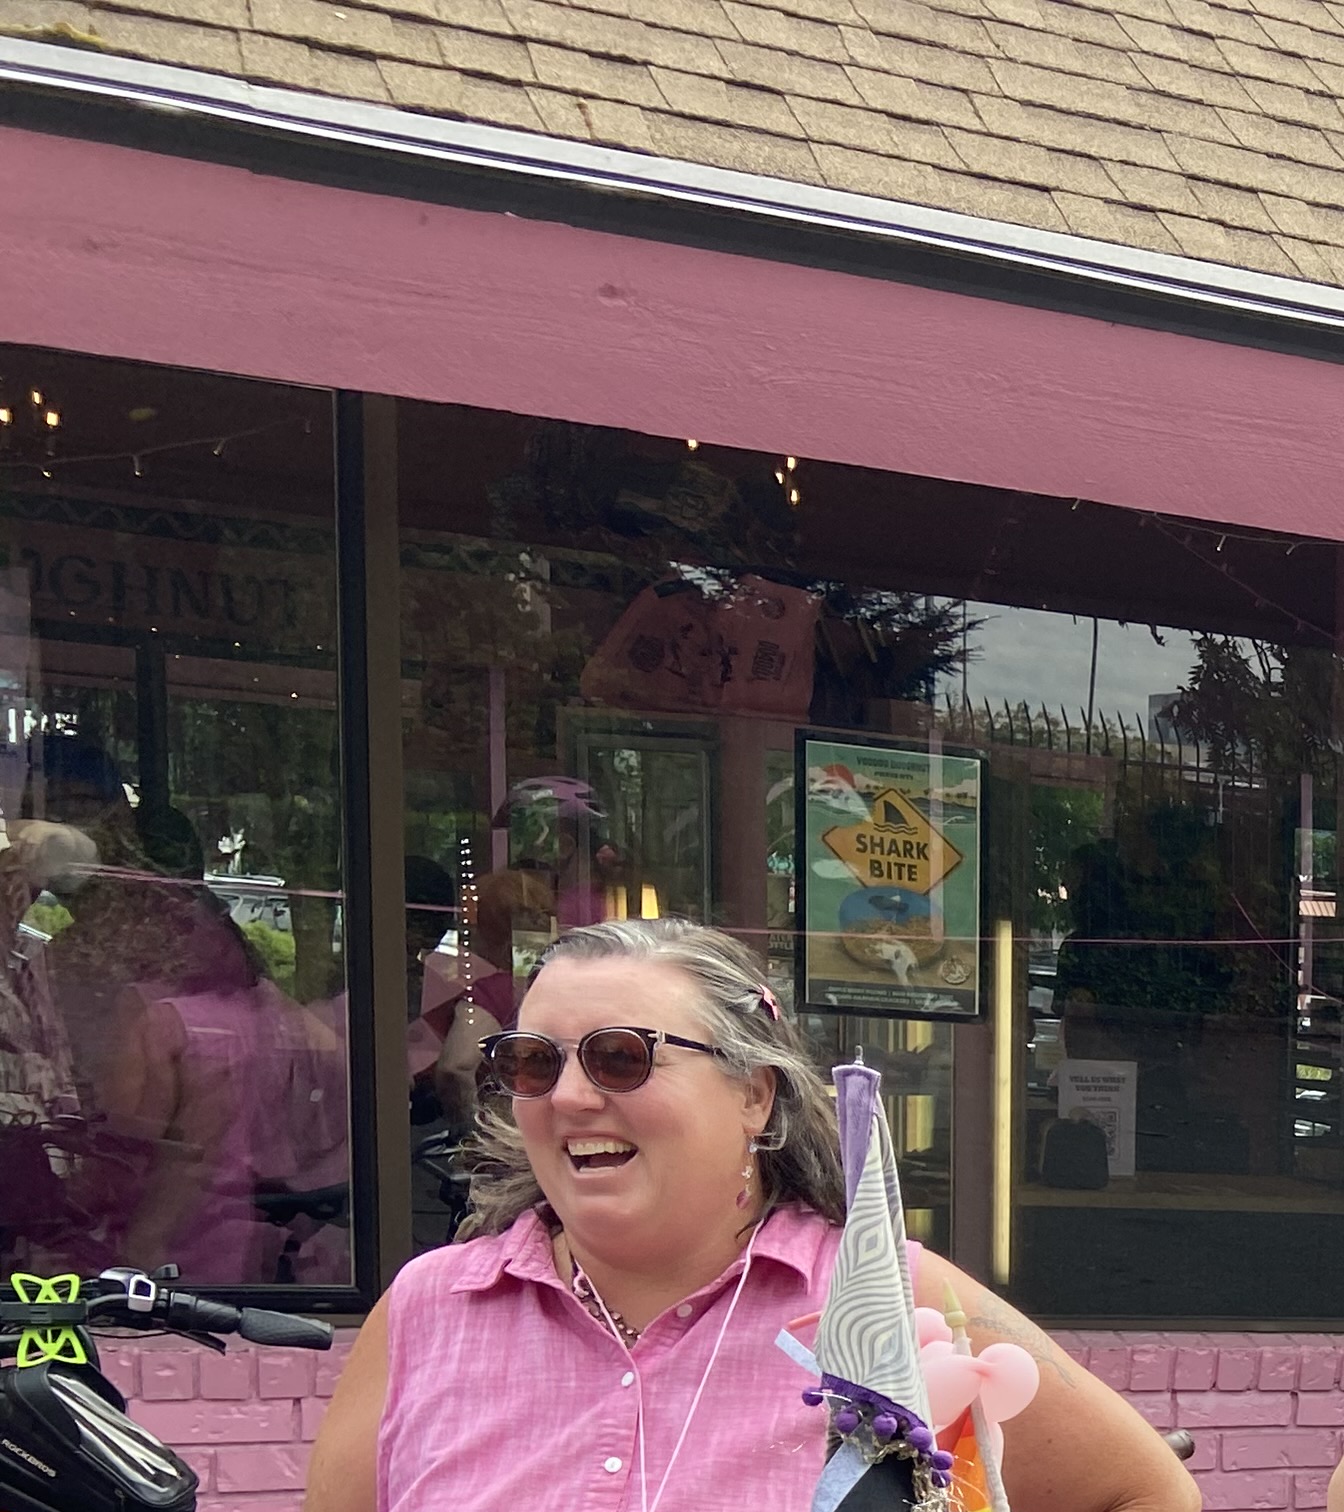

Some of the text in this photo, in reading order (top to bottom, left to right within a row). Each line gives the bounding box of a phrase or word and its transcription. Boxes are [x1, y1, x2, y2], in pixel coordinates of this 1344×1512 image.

[856, 833, 930, 862] SHARK
[869, 858, 918, 882] BITE
[1, 1438, 57, 1478] ROCKBROS
